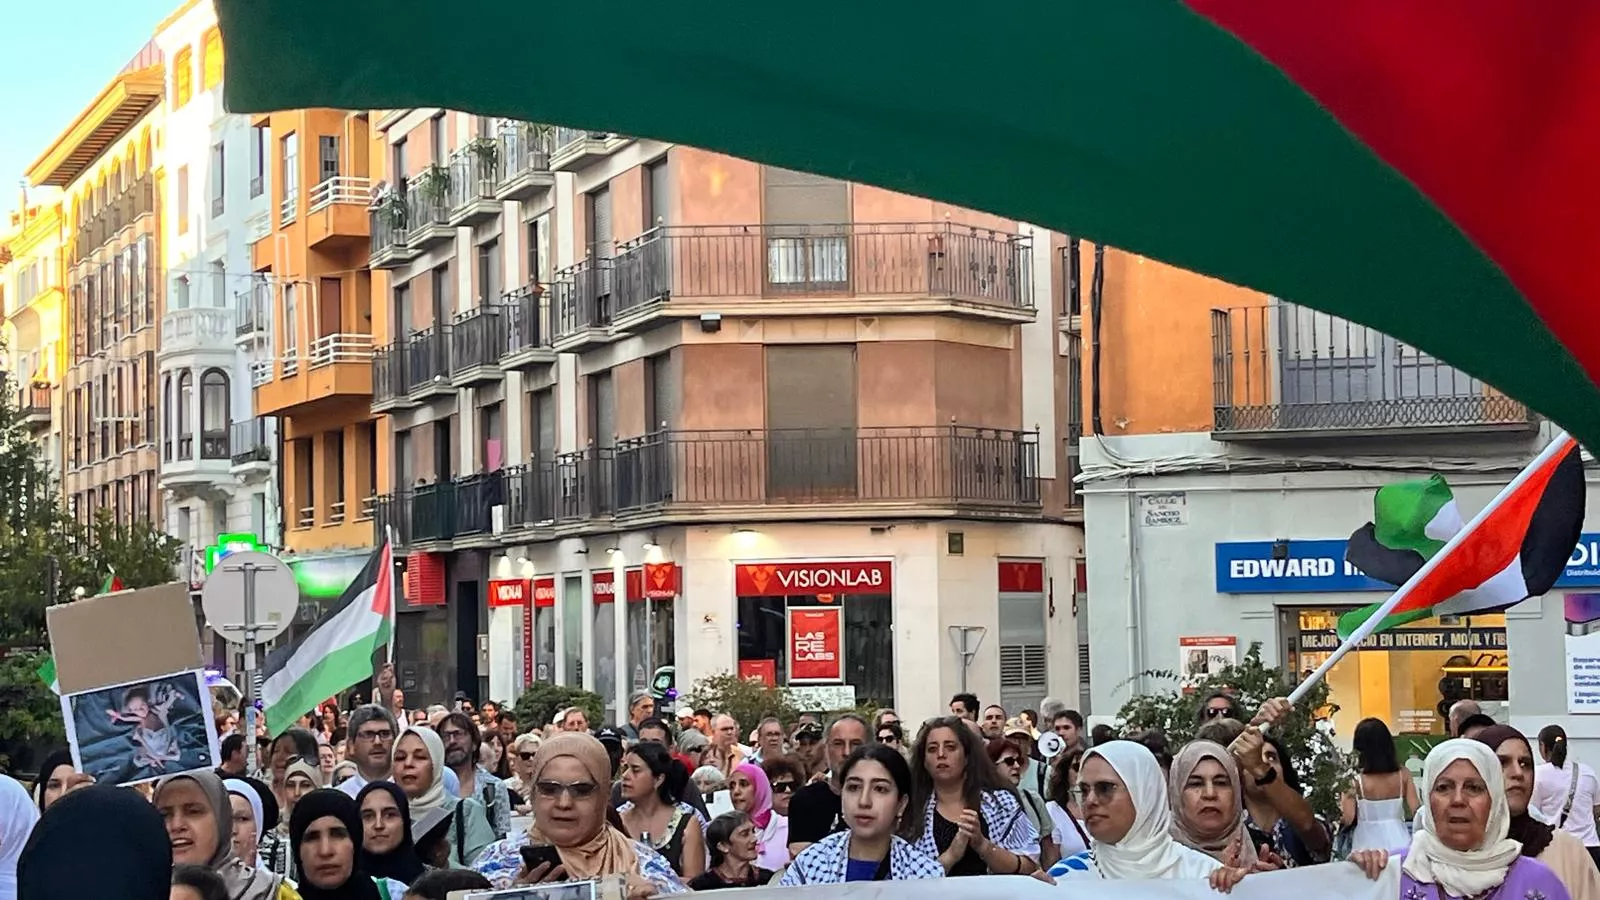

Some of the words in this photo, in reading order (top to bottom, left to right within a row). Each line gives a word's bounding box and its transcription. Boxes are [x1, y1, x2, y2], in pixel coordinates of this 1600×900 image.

[1230, 558, 1335, 578] EDWARD
[777, 569, 882, 588] VISIONLAB
[795, 632, 825, 640] LAS
[1302, 634, 1338, 647] MEJOR
[1380, 633, 1393, 647] EN
[1396, 633, 1449, 648] INTERNET,
[1484, 632, 1490, 646] Y
[795, 641, 825, 652] RE
[795, 652, 835, 661] LABS
